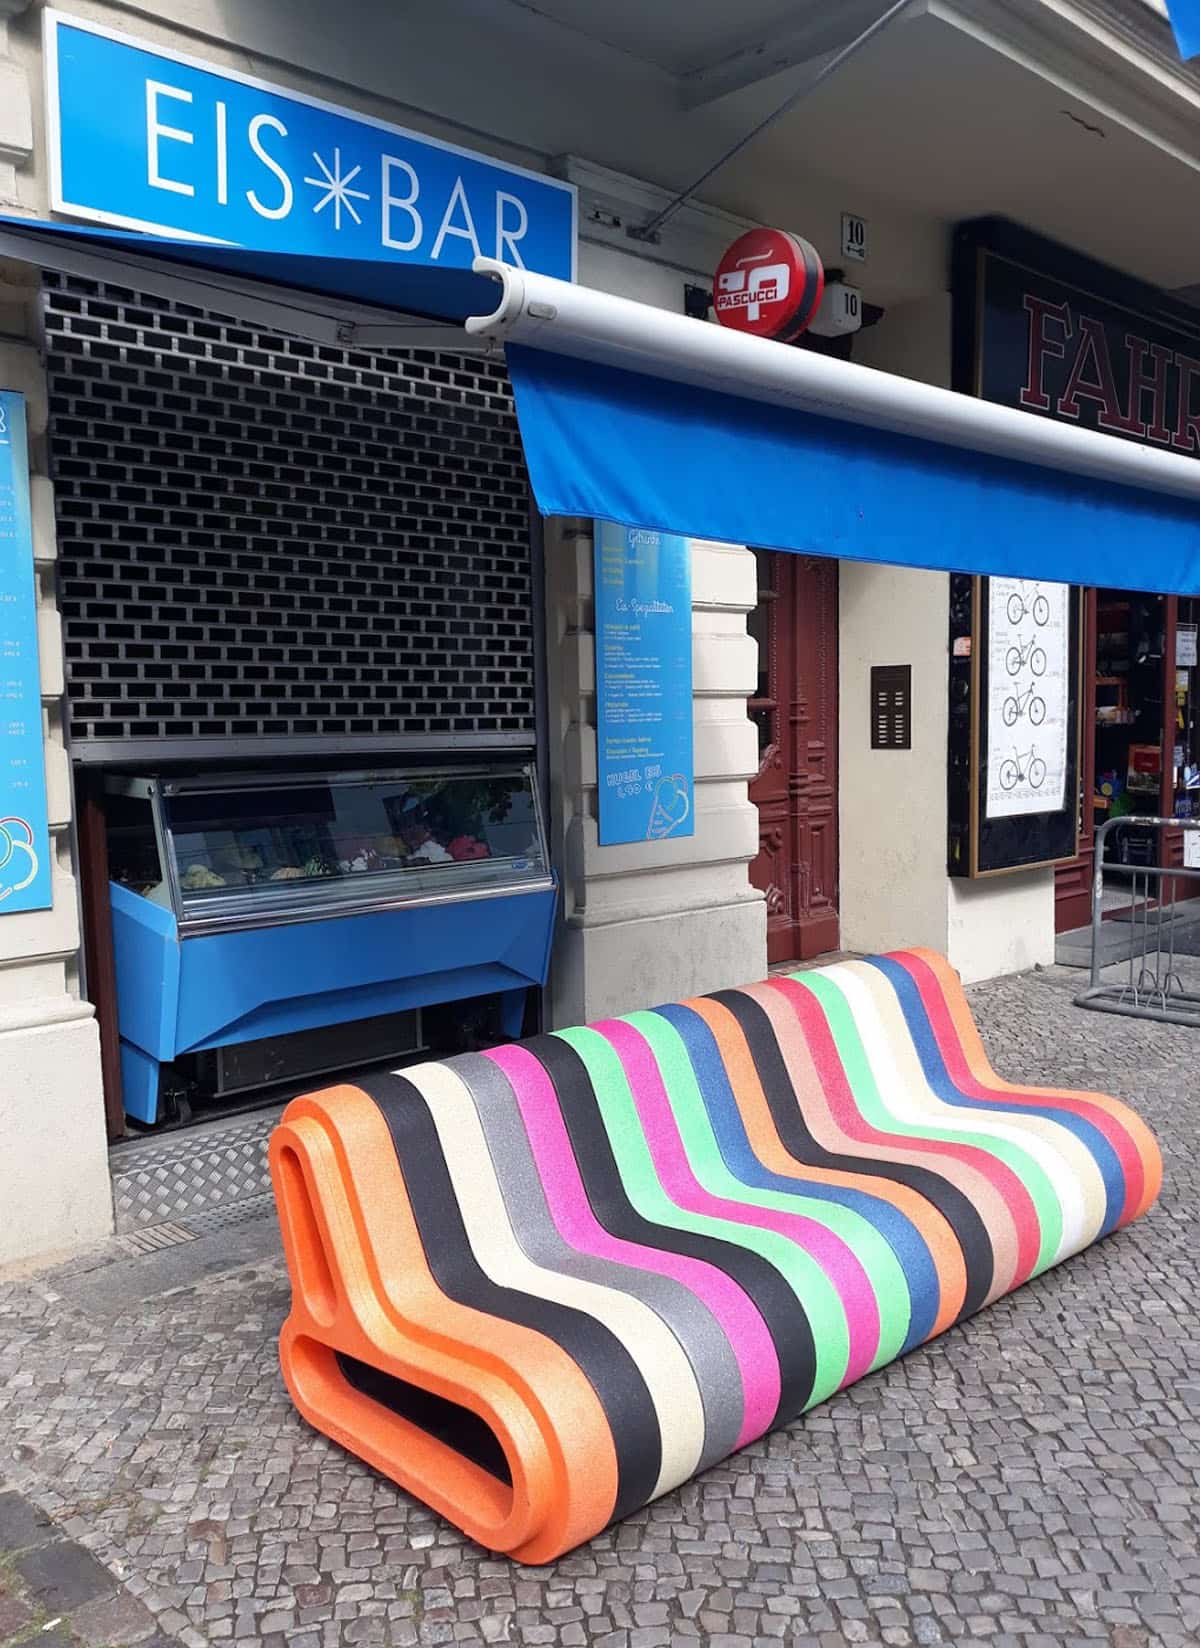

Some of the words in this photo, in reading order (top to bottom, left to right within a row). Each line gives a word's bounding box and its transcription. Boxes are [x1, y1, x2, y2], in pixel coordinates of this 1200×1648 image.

[145, 78, 294, 220] EIS
[381, 153, 528, 269] BAR
[847, 219, 865, 246] 10
[718, 288, 778, 308] PASCUCCI
[844, 292, 858, 317] 10
